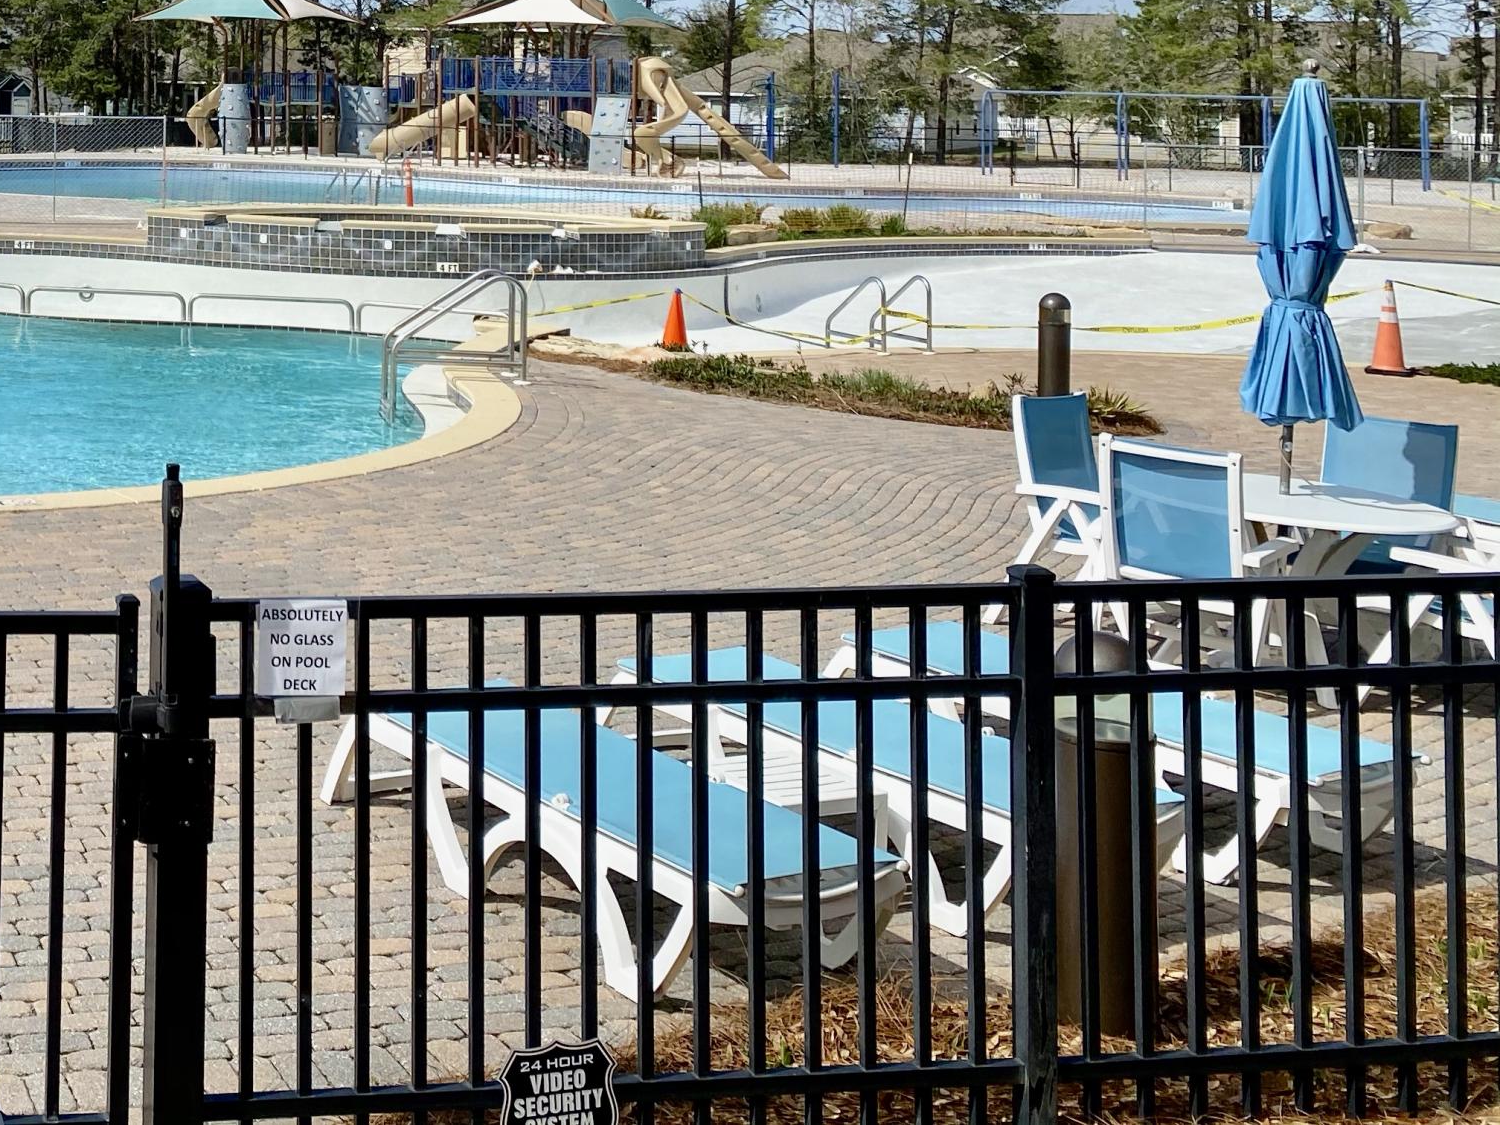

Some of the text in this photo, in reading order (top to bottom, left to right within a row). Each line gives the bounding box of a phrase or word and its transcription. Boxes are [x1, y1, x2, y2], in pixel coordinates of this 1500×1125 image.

[440, 264, 457, 272] 4 FT
[261, 608, 344, 622] ABSOLUTELY
[270, 634, 334, 646] NO GLASS
[271, 656, 331, 668] ON POOL
[283, 679, 317, 691] DECK
[520, 1053, 594, 1073] 24 HOUR
[529, 1068, 586, 1095] VIDEO
[513, 1087, 604, 1119] SECURITY
